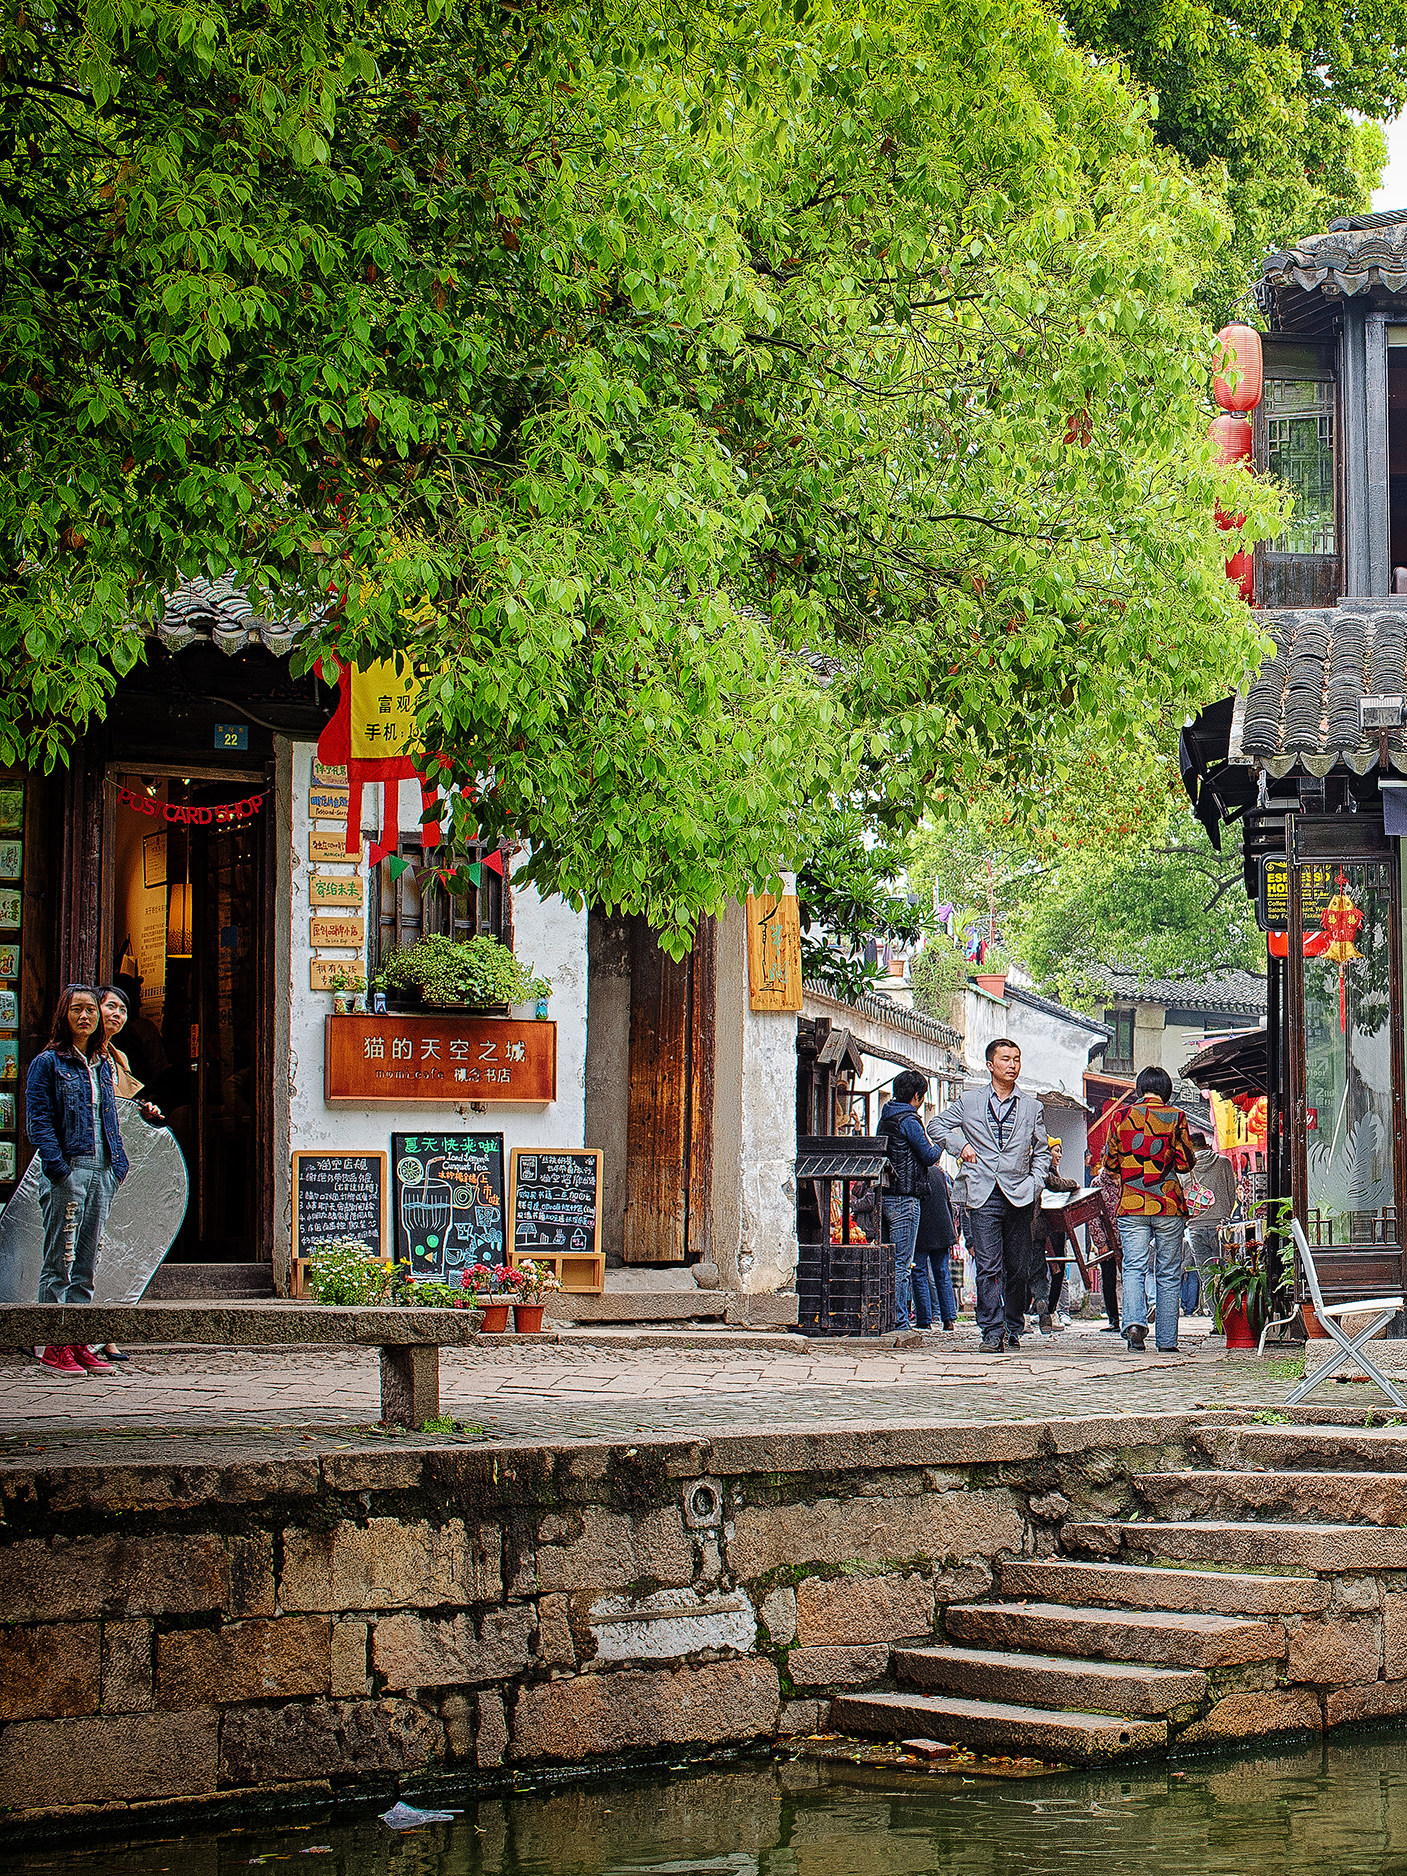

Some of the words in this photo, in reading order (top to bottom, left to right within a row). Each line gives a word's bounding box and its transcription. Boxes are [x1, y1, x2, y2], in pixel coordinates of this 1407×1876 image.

[224, 733, 238, 746] 22
[116, 787, 213, 825] POSTCARD
[214, 795, 263, 824] SHOP
[315, 880, 360, 898] 寄给未来
[313, 923, 358, 938] 原创品牌小店
[363, 1036, 526, 1063] 猫的天空之城
[454, 1067, 512, 1083] 概念书店
[404, 1137, 499, 1154] 夏天快来啦
[471, 1162, 488, 1172] Tea
